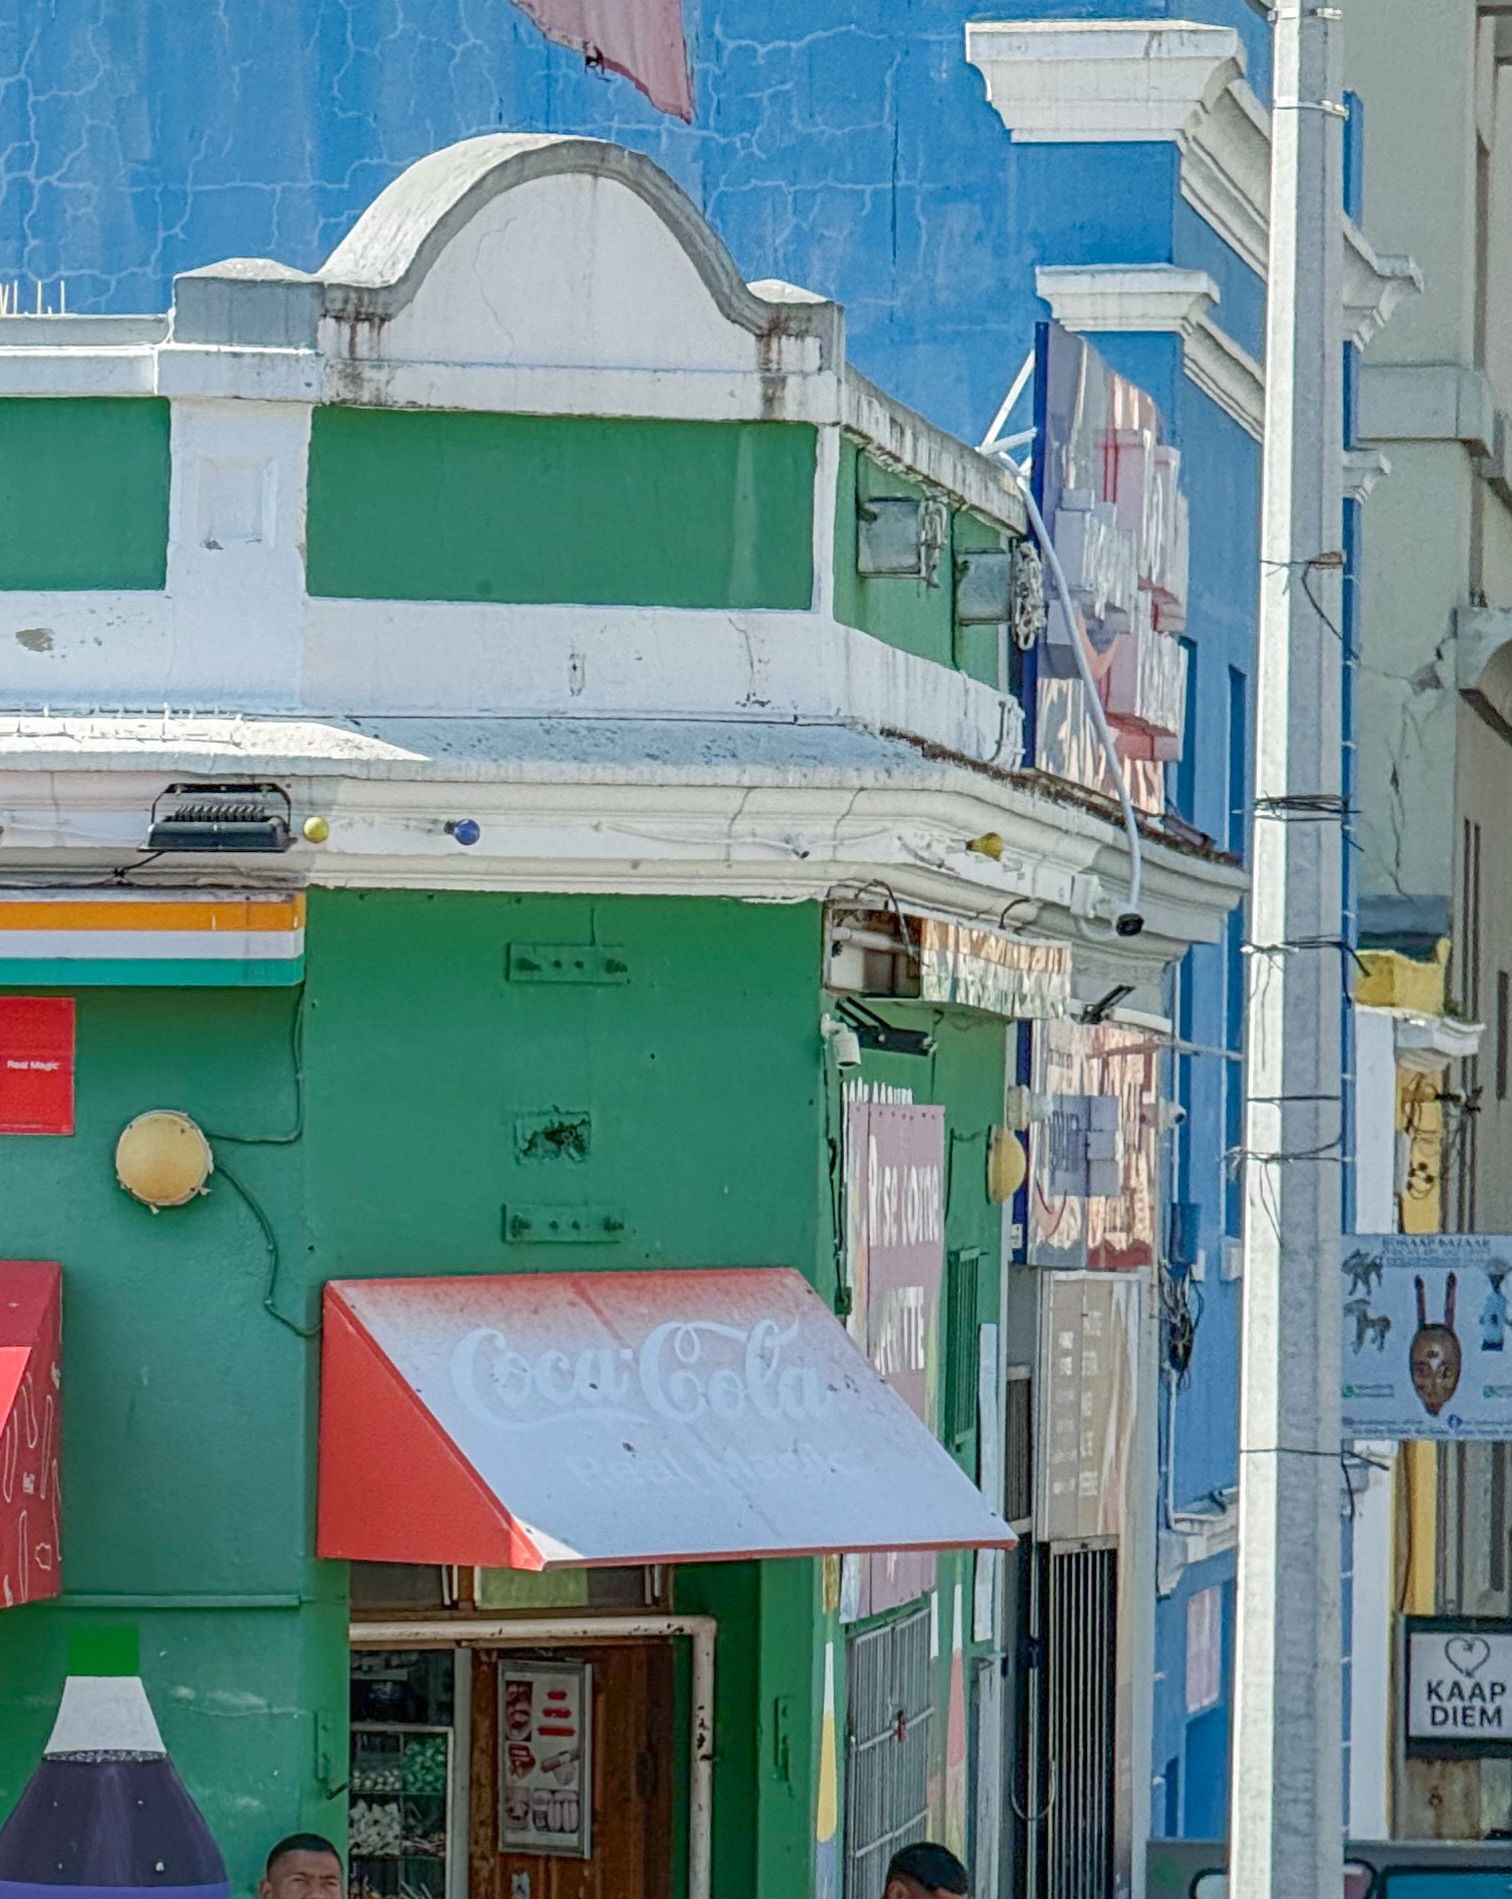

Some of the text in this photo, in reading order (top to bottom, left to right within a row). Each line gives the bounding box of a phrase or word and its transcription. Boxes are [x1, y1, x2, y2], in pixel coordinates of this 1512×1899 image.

[450, 1314, 835, 1430] Coca-Cola
[1426, 1680, 1507, 1704] KAAP
[1430, 1704, 1503, 1728] DIEM
